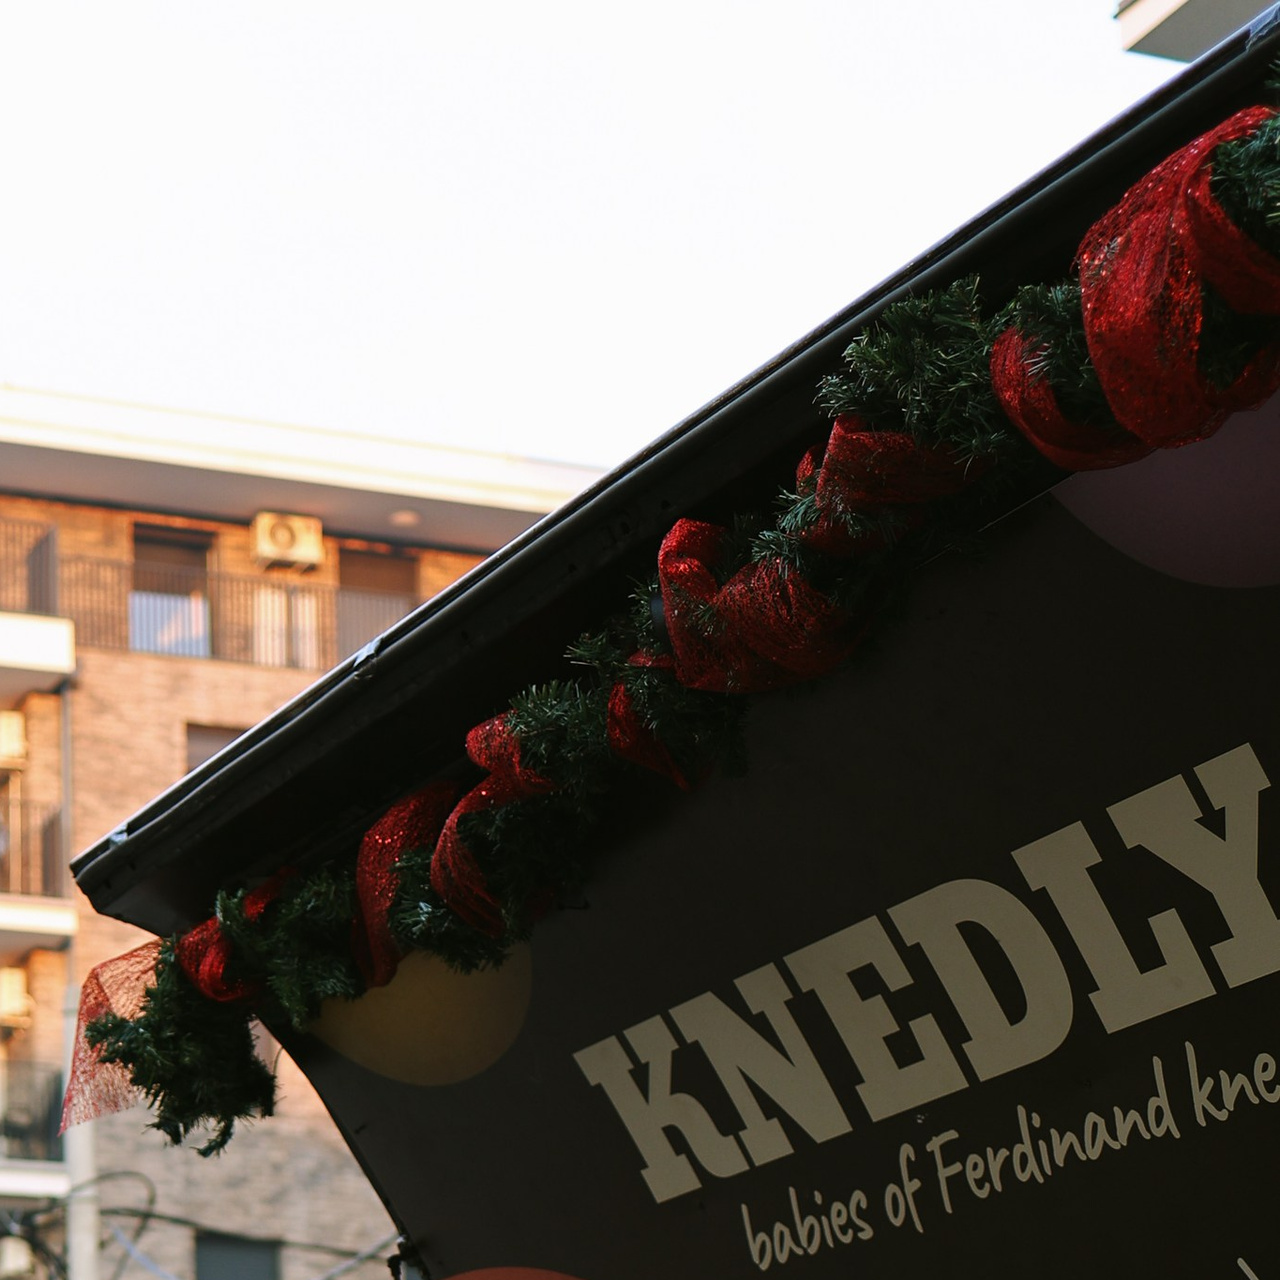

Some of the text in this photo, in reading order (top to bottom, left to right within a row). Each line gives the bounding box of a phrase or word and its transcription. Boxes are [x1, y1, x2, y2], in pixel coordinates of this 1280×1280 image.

[572, 743, 1280, 1203] KNEDLY
[741, 1187, 873, 1271] babies
[885, 1143, 923, 1233] of
[926, 1056, 1180, 1214] Ferdinand
